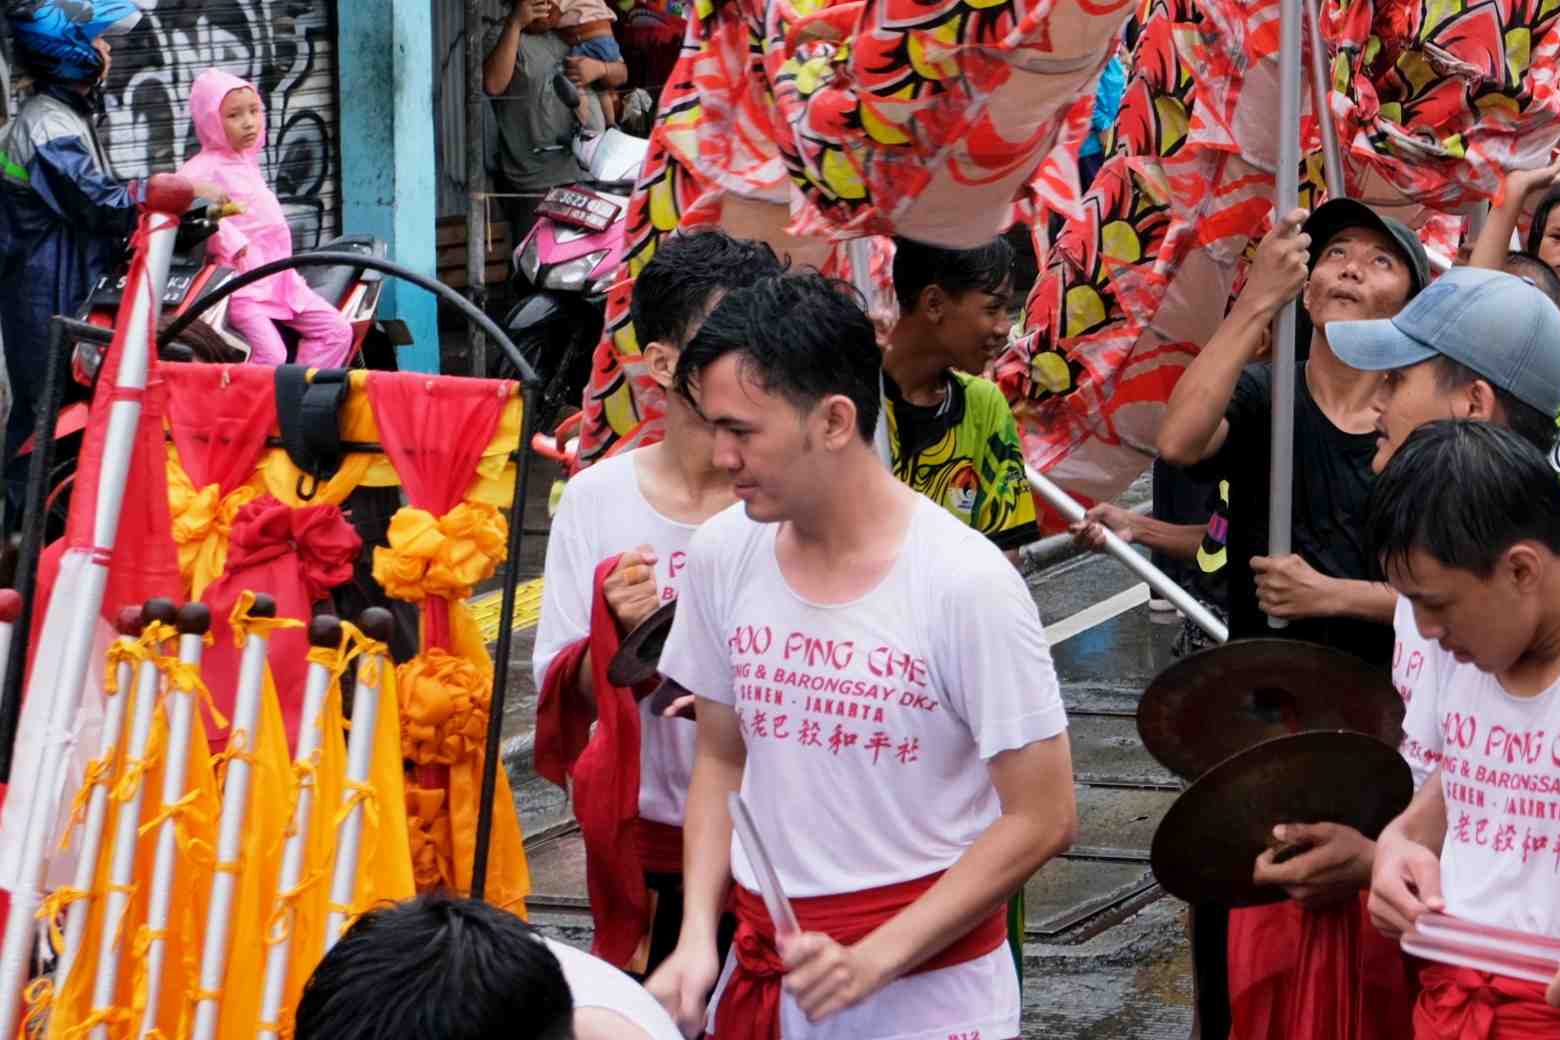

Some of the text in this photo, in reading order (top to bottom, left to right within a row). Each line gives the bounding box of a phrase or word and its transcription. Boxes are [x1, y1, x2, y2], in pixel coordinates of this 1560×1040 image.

[784, 631, 854, 670] PING
[868, 644, 929, 688] CHE
[773, 668, 896, 701] BARONGSAY
[805, 696, 886, 723] JAKARTA
